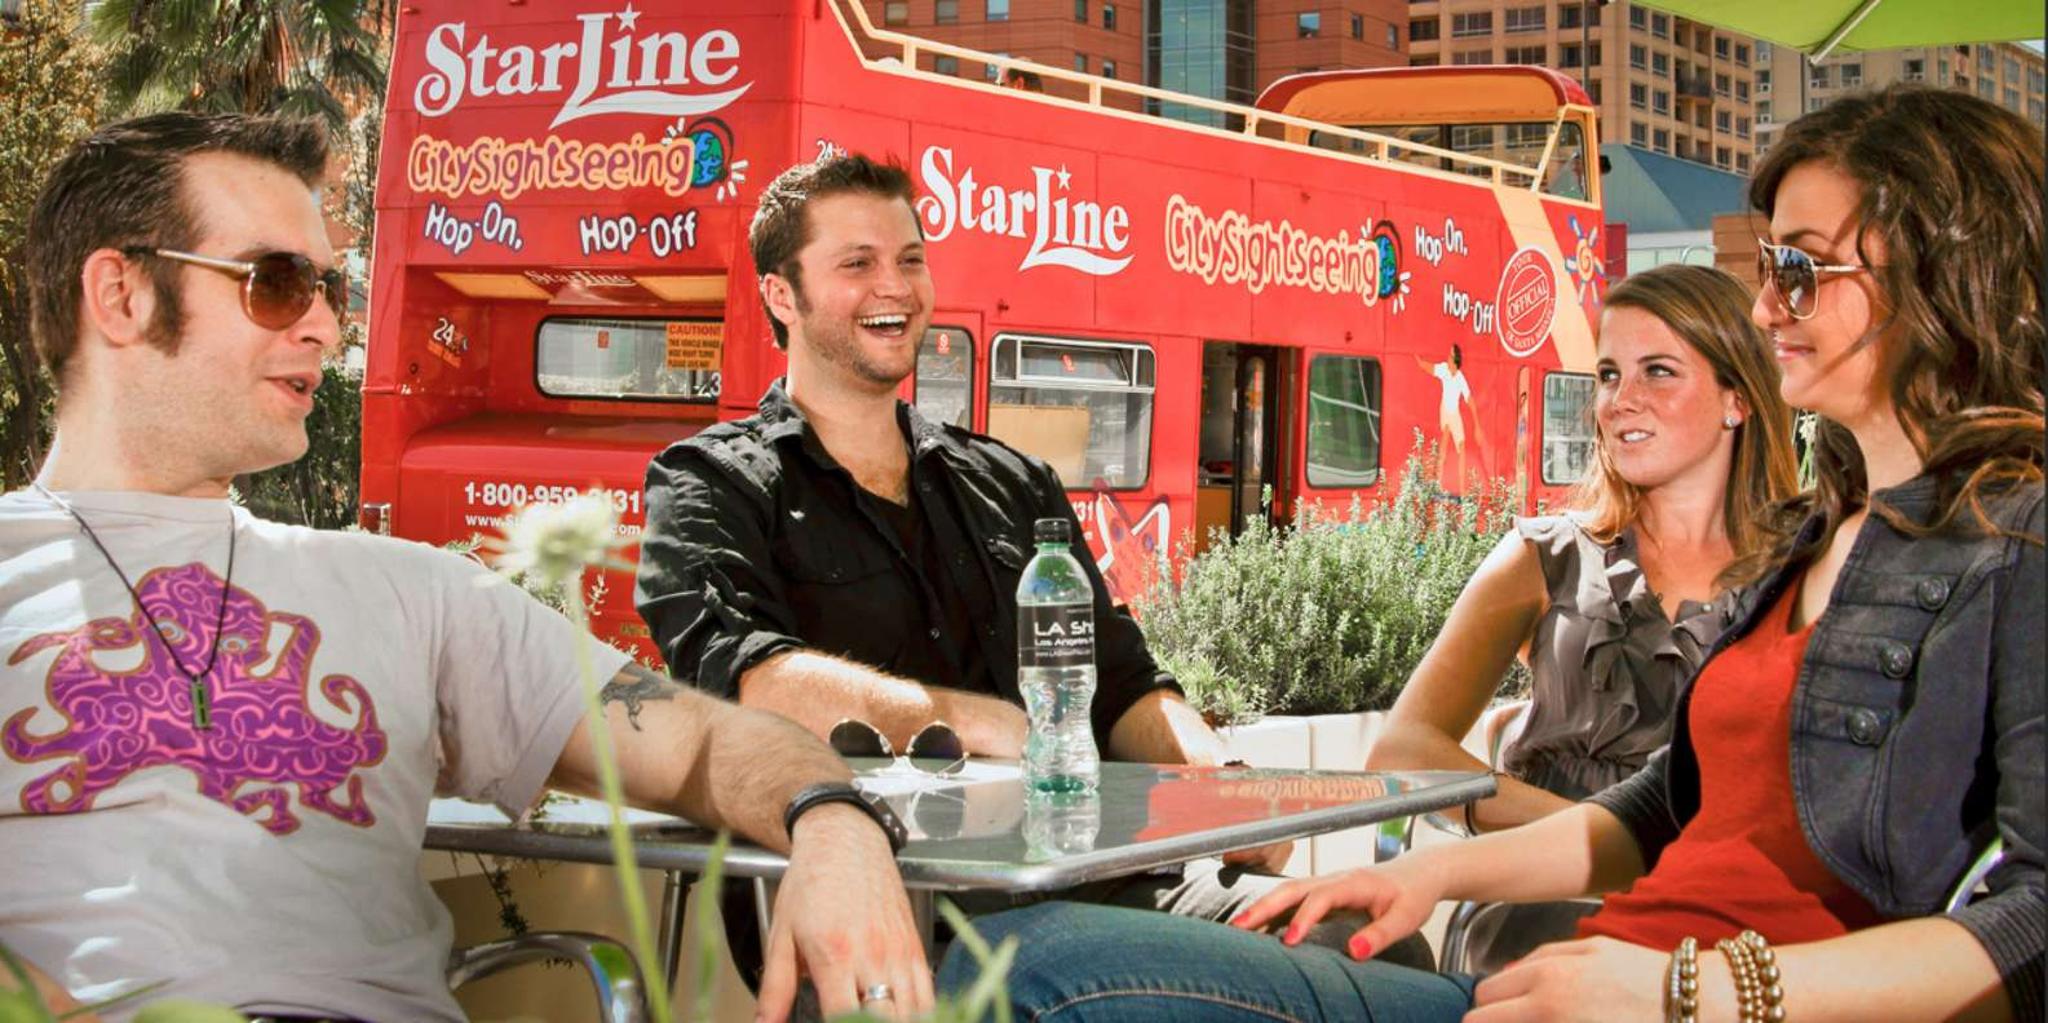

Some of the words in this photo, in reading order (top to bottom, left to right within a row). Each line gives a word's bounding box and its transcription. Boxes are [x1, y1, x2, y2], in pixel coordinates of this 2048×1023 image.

[414, 3, 755, 130] StarLine
[579, 210, 697, 258] Hop-Off
[915, 144, 1135, 276] StarLine
[1443, 283, 1494, 334] Hop-Off
[1509, 277, 1548, 320] OFFICIAL
[1033, 621, 1065, 636] LA
[1070, 620, 1095, 636] Sh
